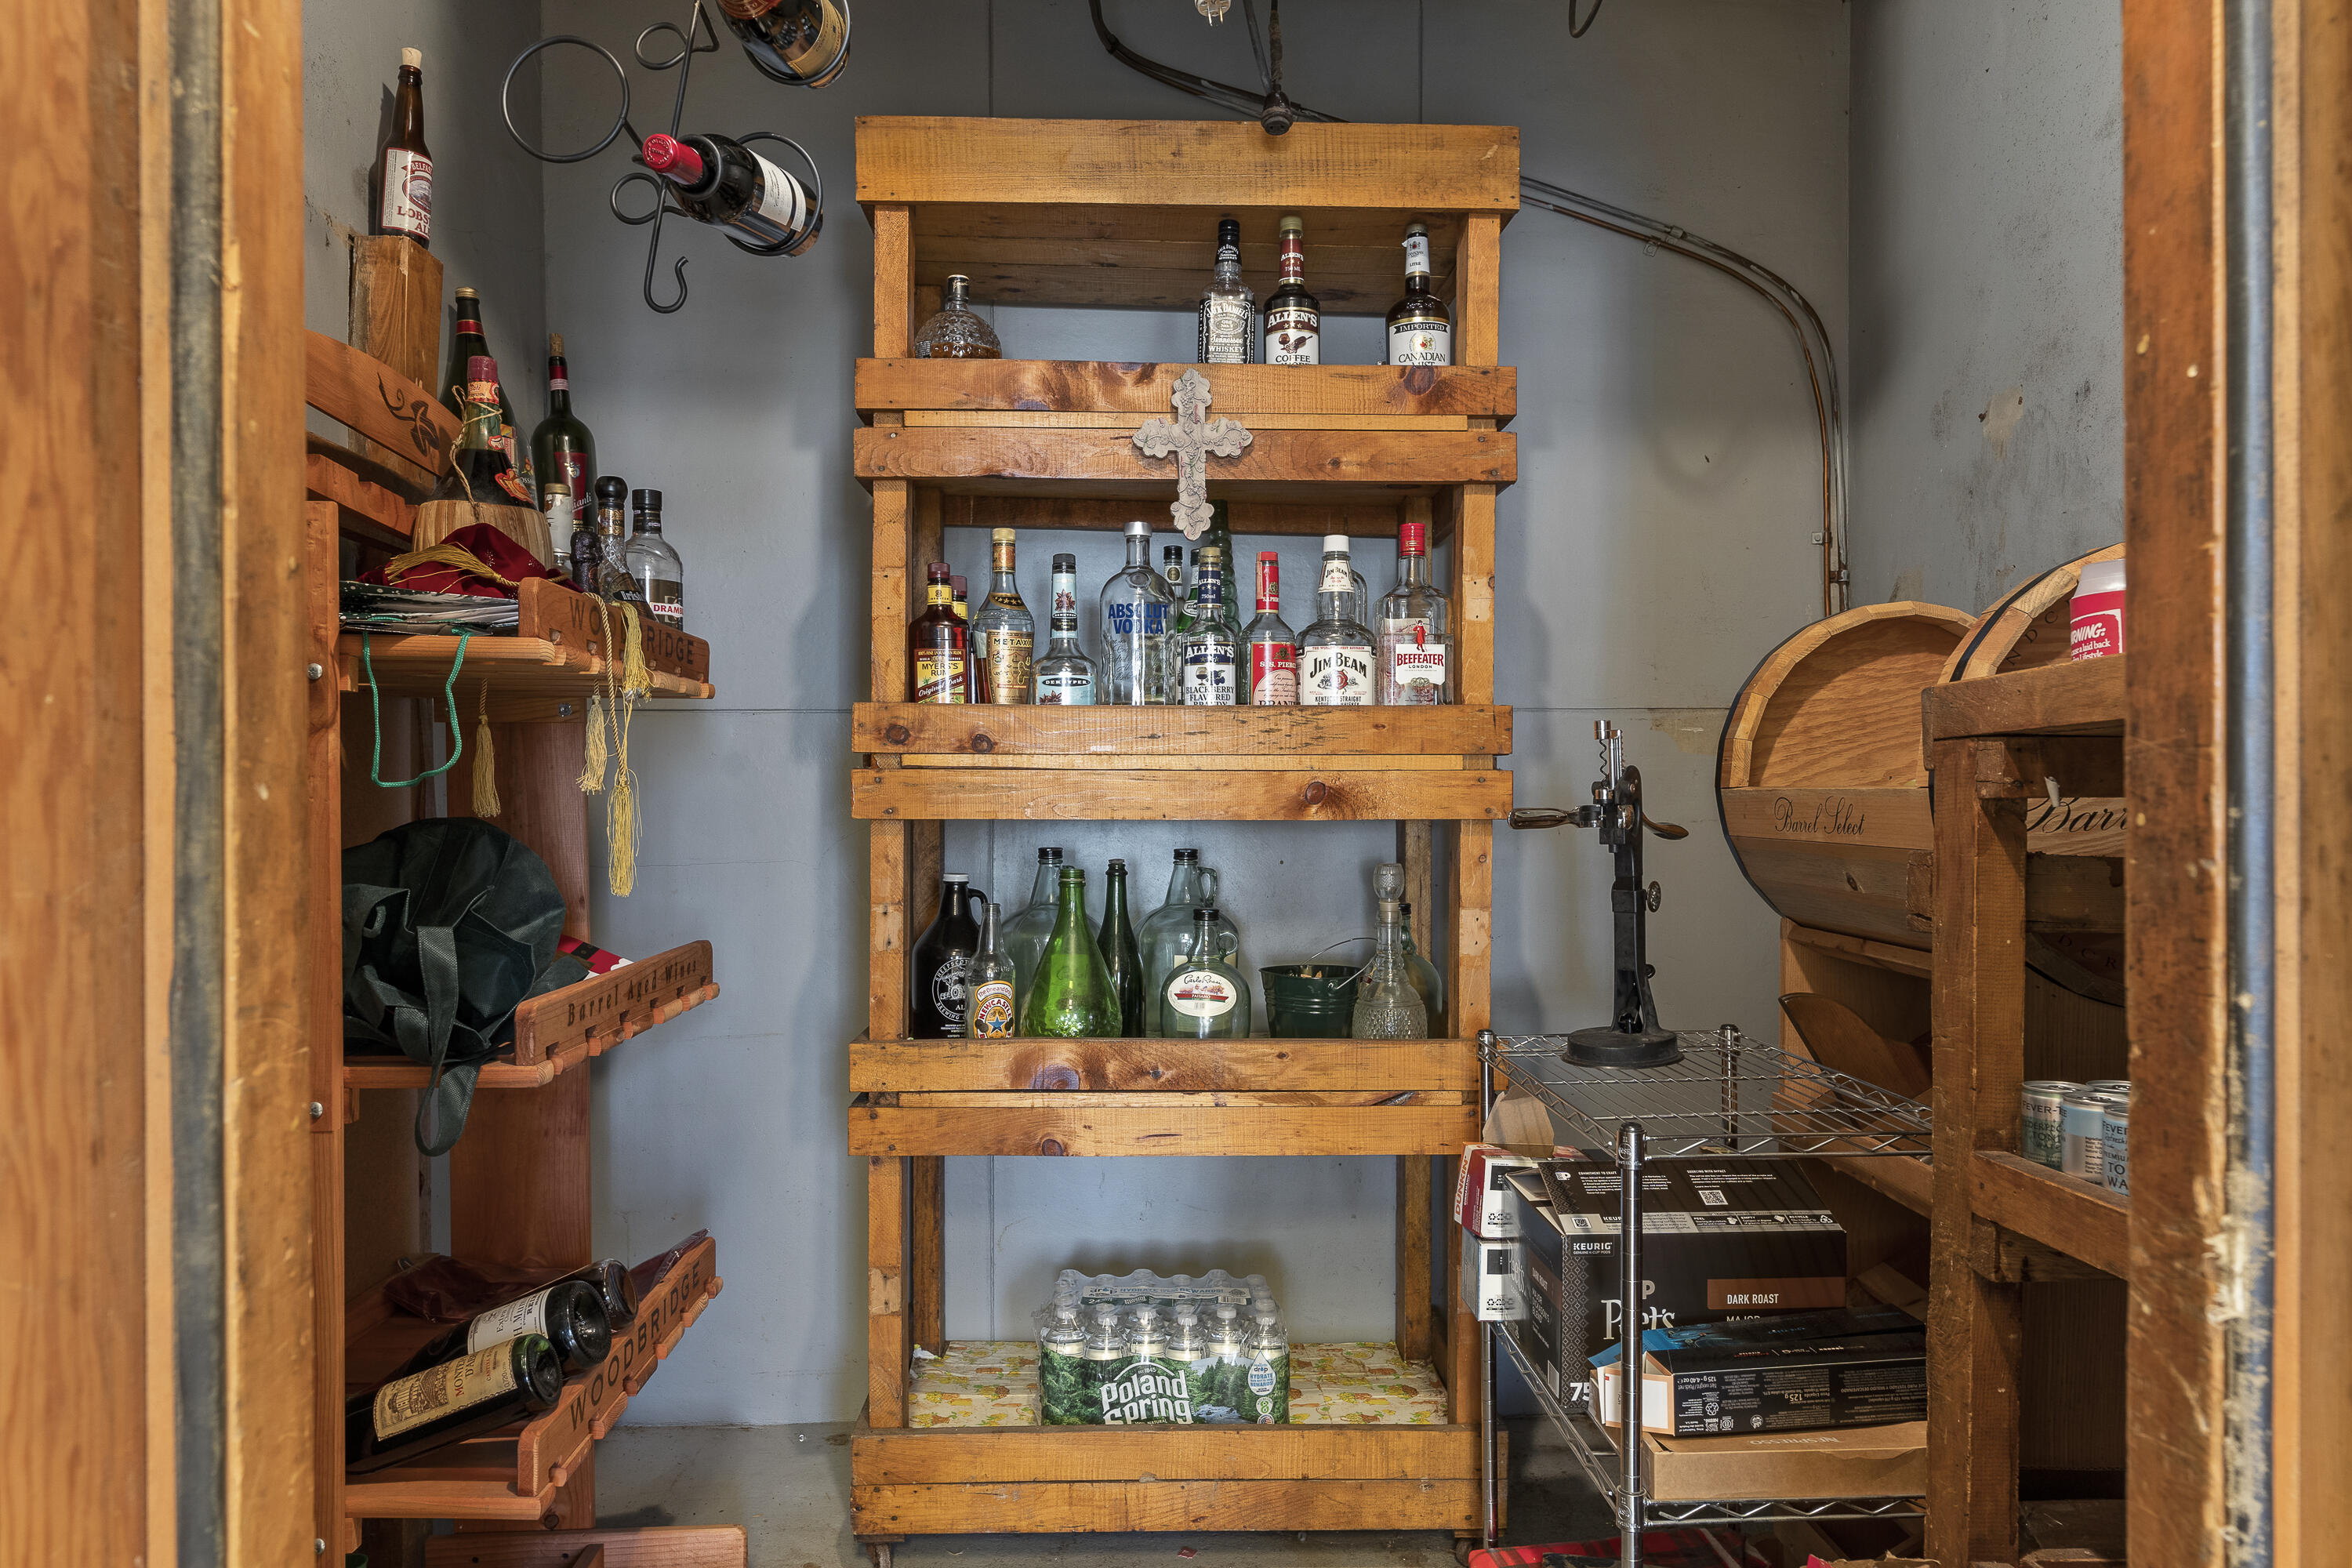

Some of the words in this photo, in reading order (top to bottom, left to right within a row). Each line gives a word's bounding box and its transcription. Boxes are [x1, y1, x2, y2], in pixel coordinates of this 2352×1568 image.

[1206, 303, 1223, 318] JACK
[1223, 302, 1249, 320] DANIEL'S
[1267, 310, 1318, 329] ALLEN'S
[1399, 324, 1445, 333] IMPORTED
[1398, 352, 1446, 363] CANADIAN
[1199, 578, 1221, 586] ALLEN'S
[1108, 603, 1168, 619] ABSOLUT
[569, 596, 694, 666] WOORIDGE
[1113, 619, 1164, 634] VODKA
[993, 637, 1033, 647] METAXA
[2093, 638, 2111, 648] back
[1309, 657, 1332, 679] JIM
[1334, 652, 1367, 679] BEAM
[1396, 653, 1444, 666] BEEFEATER
[918, 681, 946, 697] Original
[949, 676, 963, 686] Dark
[1774, 797, 1823, 833] Barrel
[1824, 795, 1865, 836] Select
[1184, 974, 1202, 984] Carlo
[568, 984, 618, 1027] Barrel
[627, 969, 657, 1003] Aged
[978, 989, 986, 998] The
[936, 1002, 960, 1020] BREWING
[978, 999, 1012, 1020] NEWCASTLE
[1727, 1294, 1749, 1305] DARK
[1752, 1294, 1779, 1304] ROAST
[1600, 1300, 1675, 1340] Pt's
[570, 1260, 700, 1432] WOODBRIDGE
[1099, 1369, 1189, 1414] Poland
[1102, 1394, 1194, 1425] Spring
[1749, 1436, 1840, 1445] NESPRESSO
